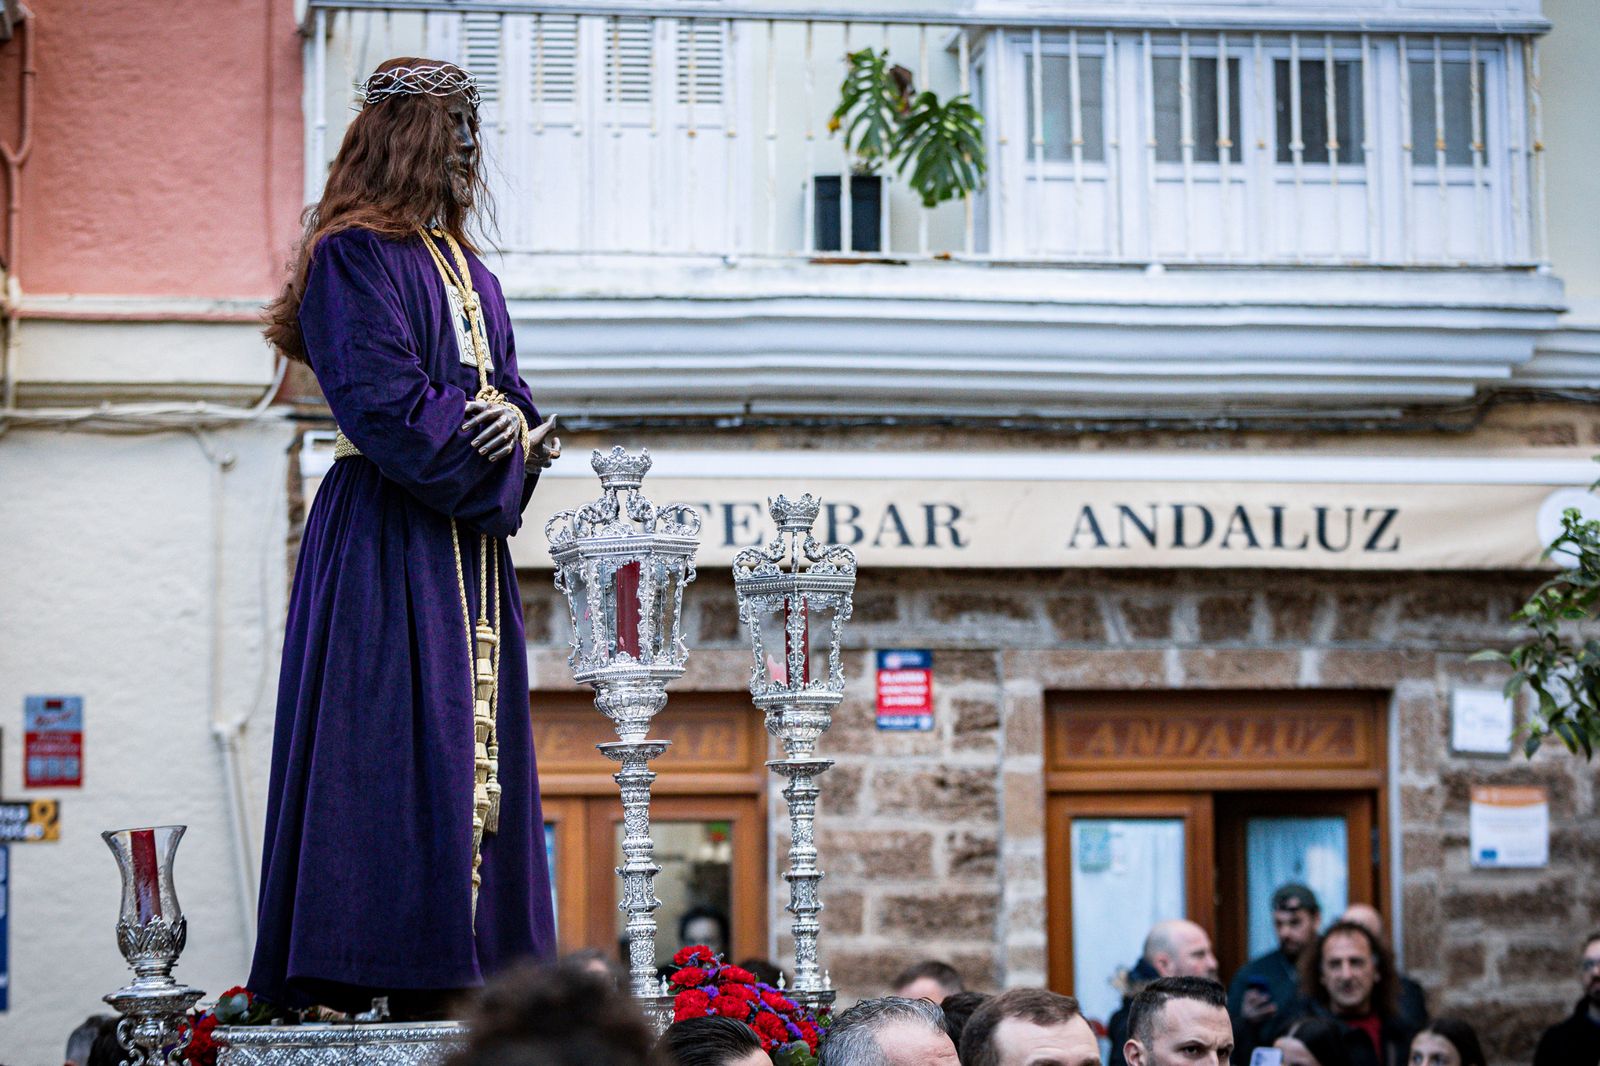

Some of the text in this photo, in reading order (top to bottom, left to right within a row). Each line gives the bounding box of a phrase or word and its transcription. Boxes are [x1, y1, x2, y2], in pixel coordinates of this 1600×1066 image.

[825, 502, 969, 548] BAR
[1068, 503, 1400, 552] ANDALUZ
[1082, 720, 1345, 760] ANDALUZ
